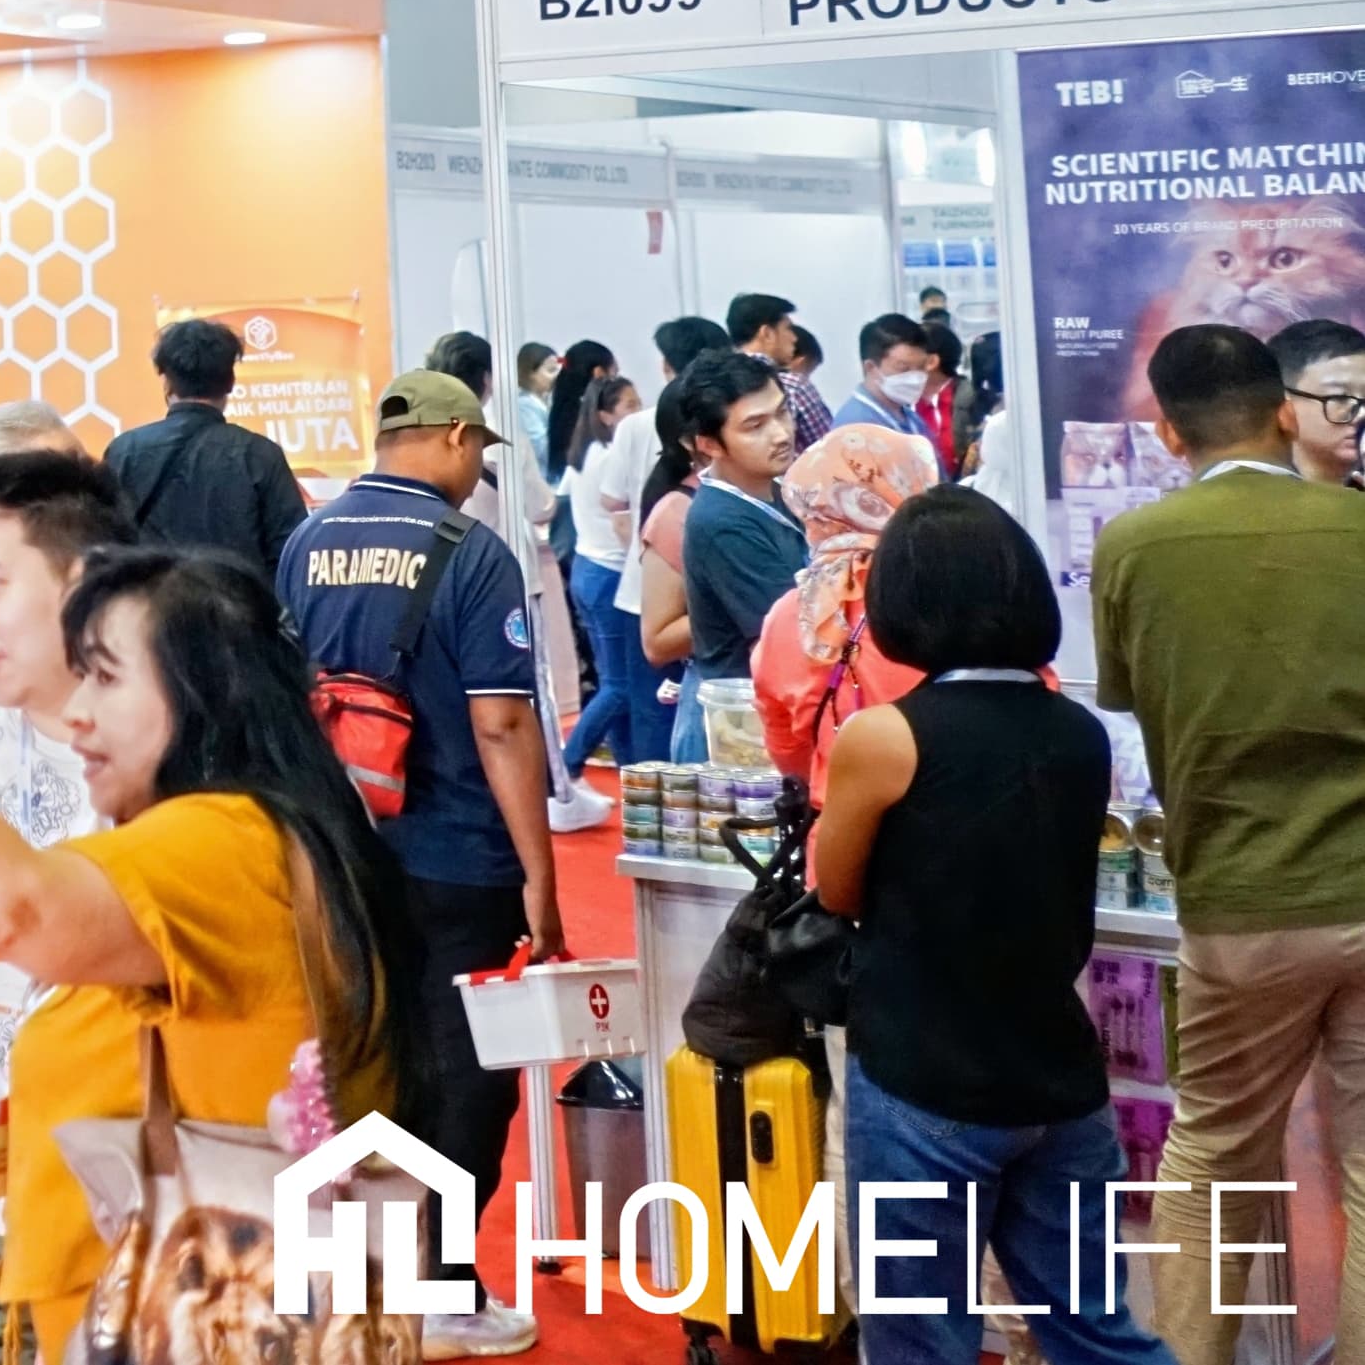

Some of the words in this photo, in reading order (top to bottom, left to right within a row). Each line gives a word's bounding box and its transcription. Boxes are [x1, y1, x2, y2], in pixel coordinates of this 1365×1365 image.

[1057, 79, 1123, 107] TEB!
[1051, 147, 1220, 177] SCIENTIFIC
[1045, 175, 1255, 205] NUTRITIONAL
[1113, 224, 1128, 235] 10
[1131, 222, 1170, 234] YEARS
[1173, 221, 1190, 233] OF
[1054, 316, 1089, 329] RAW
[250, 380, 348, 398] KEMITRAAN
[259, 400, 310, 416] MULAI
[315, 397, 352, 413] DARI
[308, 547, 427, 589] PARAMEDIC
